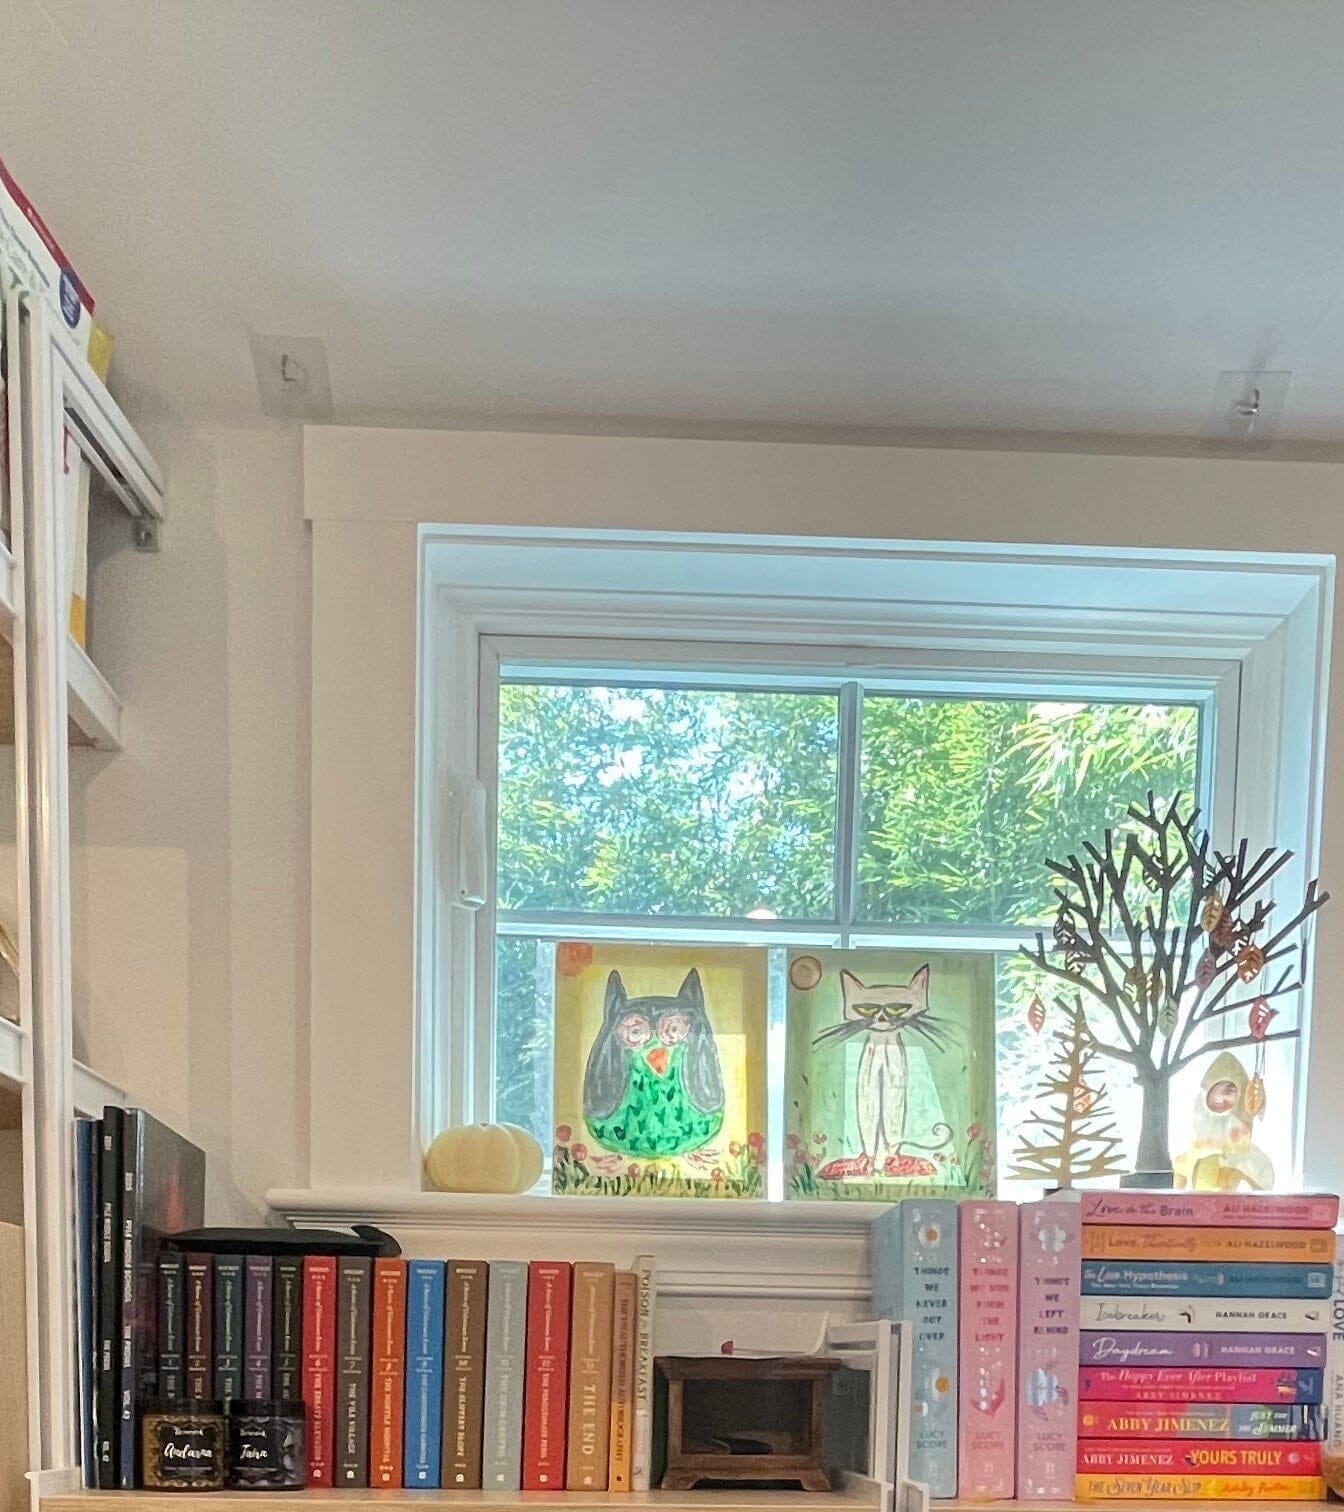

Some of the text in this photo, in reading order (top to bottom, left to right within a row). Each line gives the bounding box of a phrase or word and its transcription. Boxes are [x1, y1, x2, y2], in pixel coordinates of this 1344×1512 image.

[1123, 1270, 1187, 1283] Hypothesis
[924, 1283, 939, 1292] WE
[1044, 1294, 1060, 1303] WE
[1094, 1302, 1287, 1322] Icebreaker HANNAH GRACE
[638, 1269, 652, 1401] POISON BREAKFAST
[1091, 1337, 1295, 1361] Daydream HANNAH GRACE
[349, 1383, 357, 1398] THE
[1333, 1375, 1344, 1401] ANA
[582, 1384, 596, 1455] THE END
[1107, 1418, 1228, 1432] ABBY JIMENEZ
[1333, 1404, 1344, 1448] HUANG
[1083, 1454, 1113, 1465] ABBY
[1116, 1454, 1174, 1466] JIMENEZ
[1190, 1450, 1237, 1466] YOURS
[1238, 1450, 1282, 1466] TRULY
